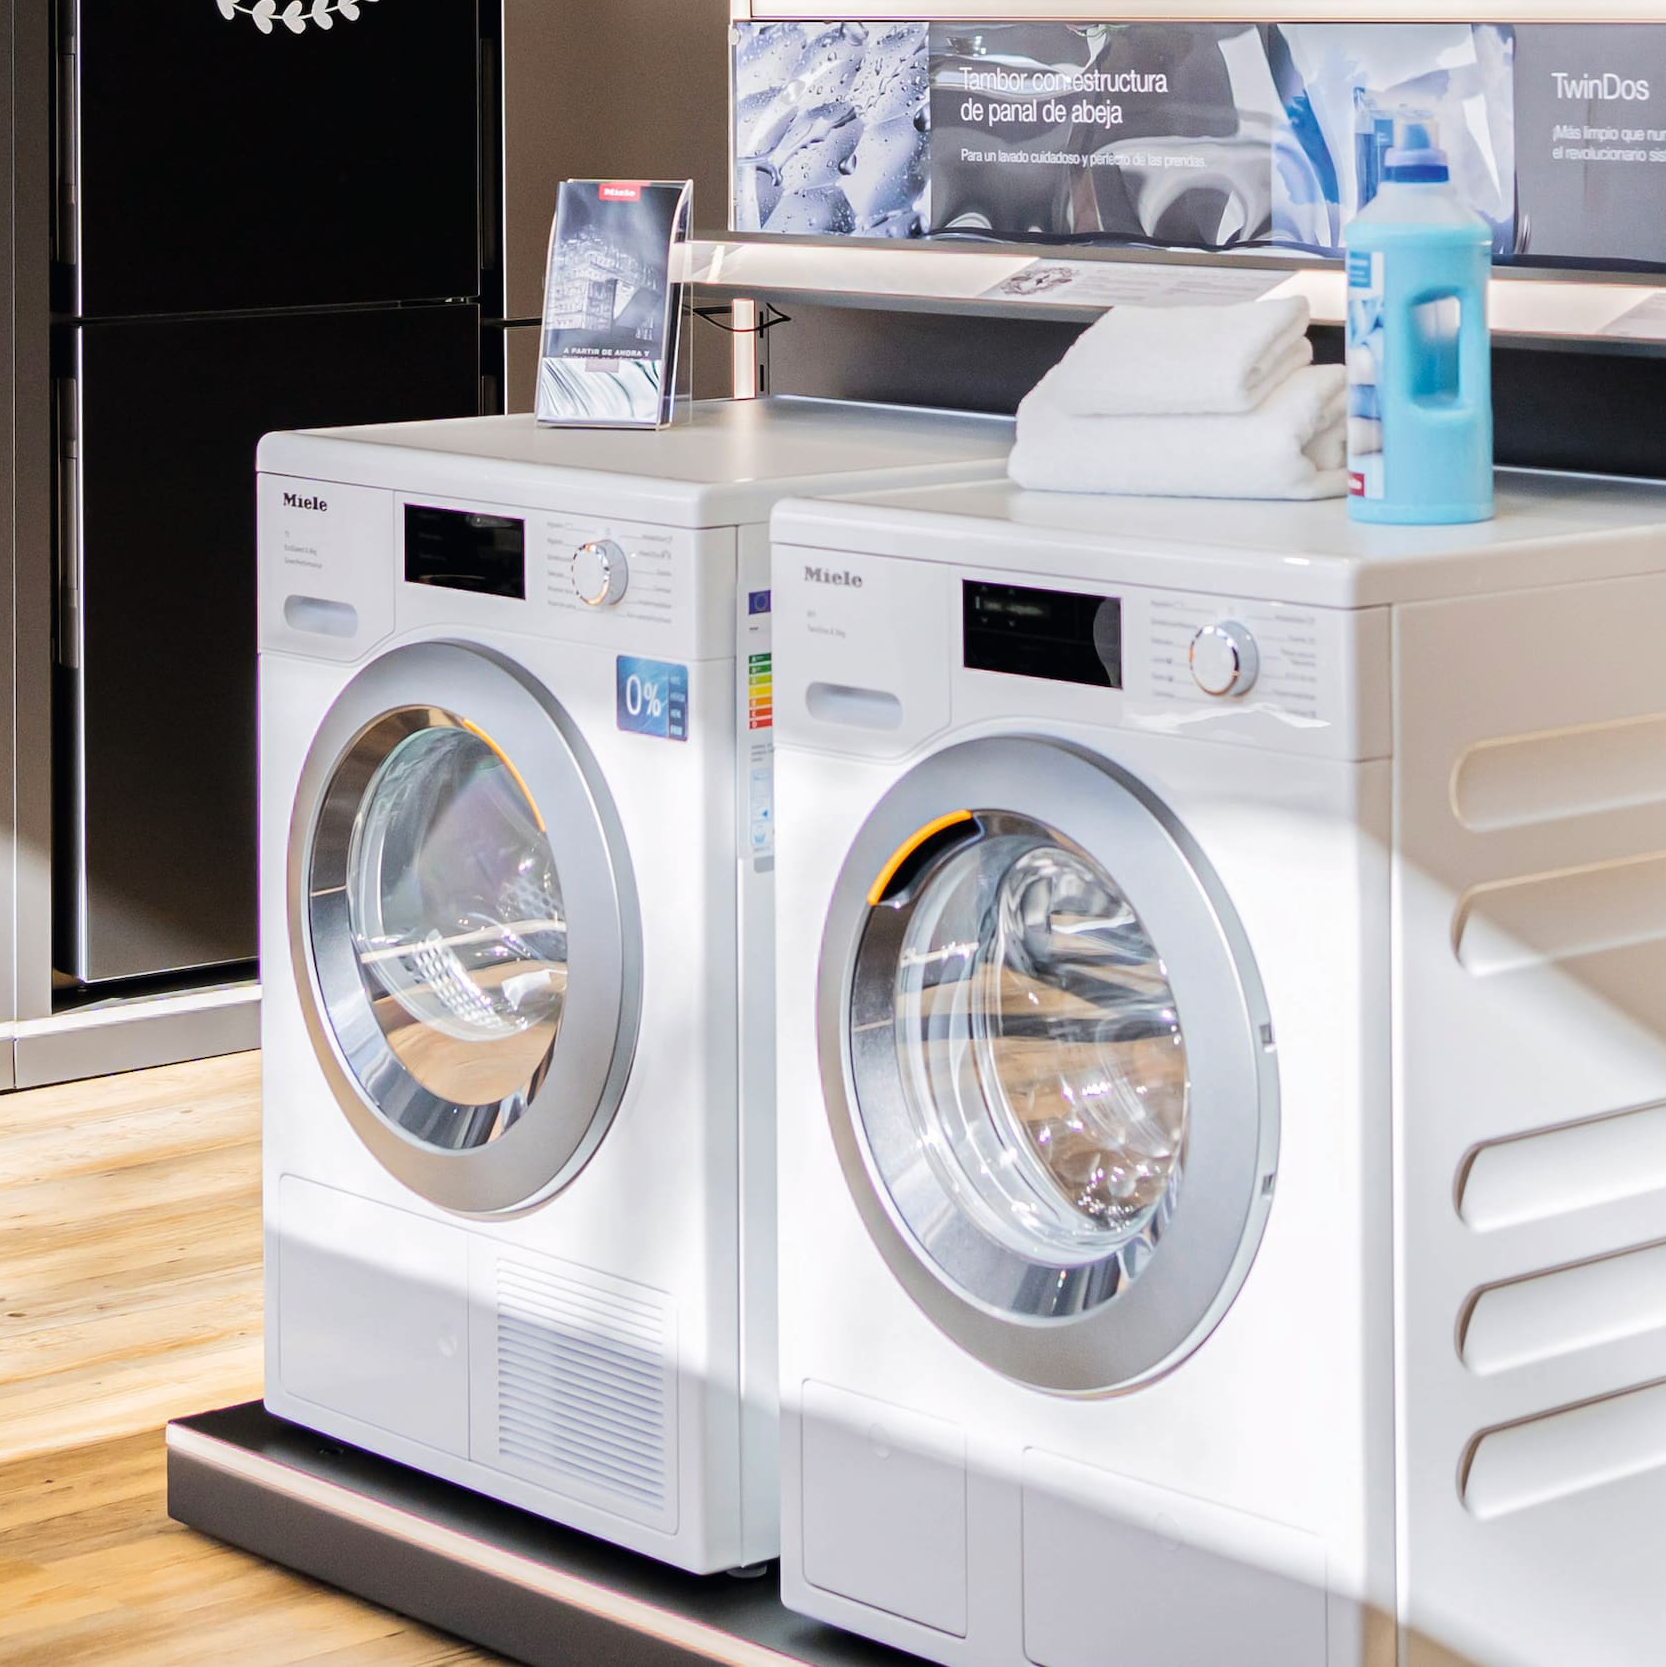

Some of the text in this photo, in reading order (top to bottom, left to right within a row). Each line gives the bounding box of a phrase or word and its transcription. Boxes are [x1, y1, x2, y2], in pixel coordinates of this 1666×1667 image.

[959, 67, 1027, 91] Tambor
[1073, 69, 1168, 93] estructura
[1552, 73, 1649, 101] TwinDos
[961, 98, 1122, 129] de panal de abeja
[1584, 126, 1618, 142] limpio
[1621, 130, 1644, 143] que
[961, 149, 982, 162] Para
[985, 153, 996, 162] un
[998, 150, 1028, 164] lavado
[1031, 151, 1079, 165] cuidadoso
[1553, 145, 1564, 160] el
[1565, 147, 1646, 161] revolucionario
[603, 188, 636, 198] Miele
[283, 492, 328, 513] Miele
[804, 566, 863, 588] Miele
[626, 675, 661, 718] 0%
